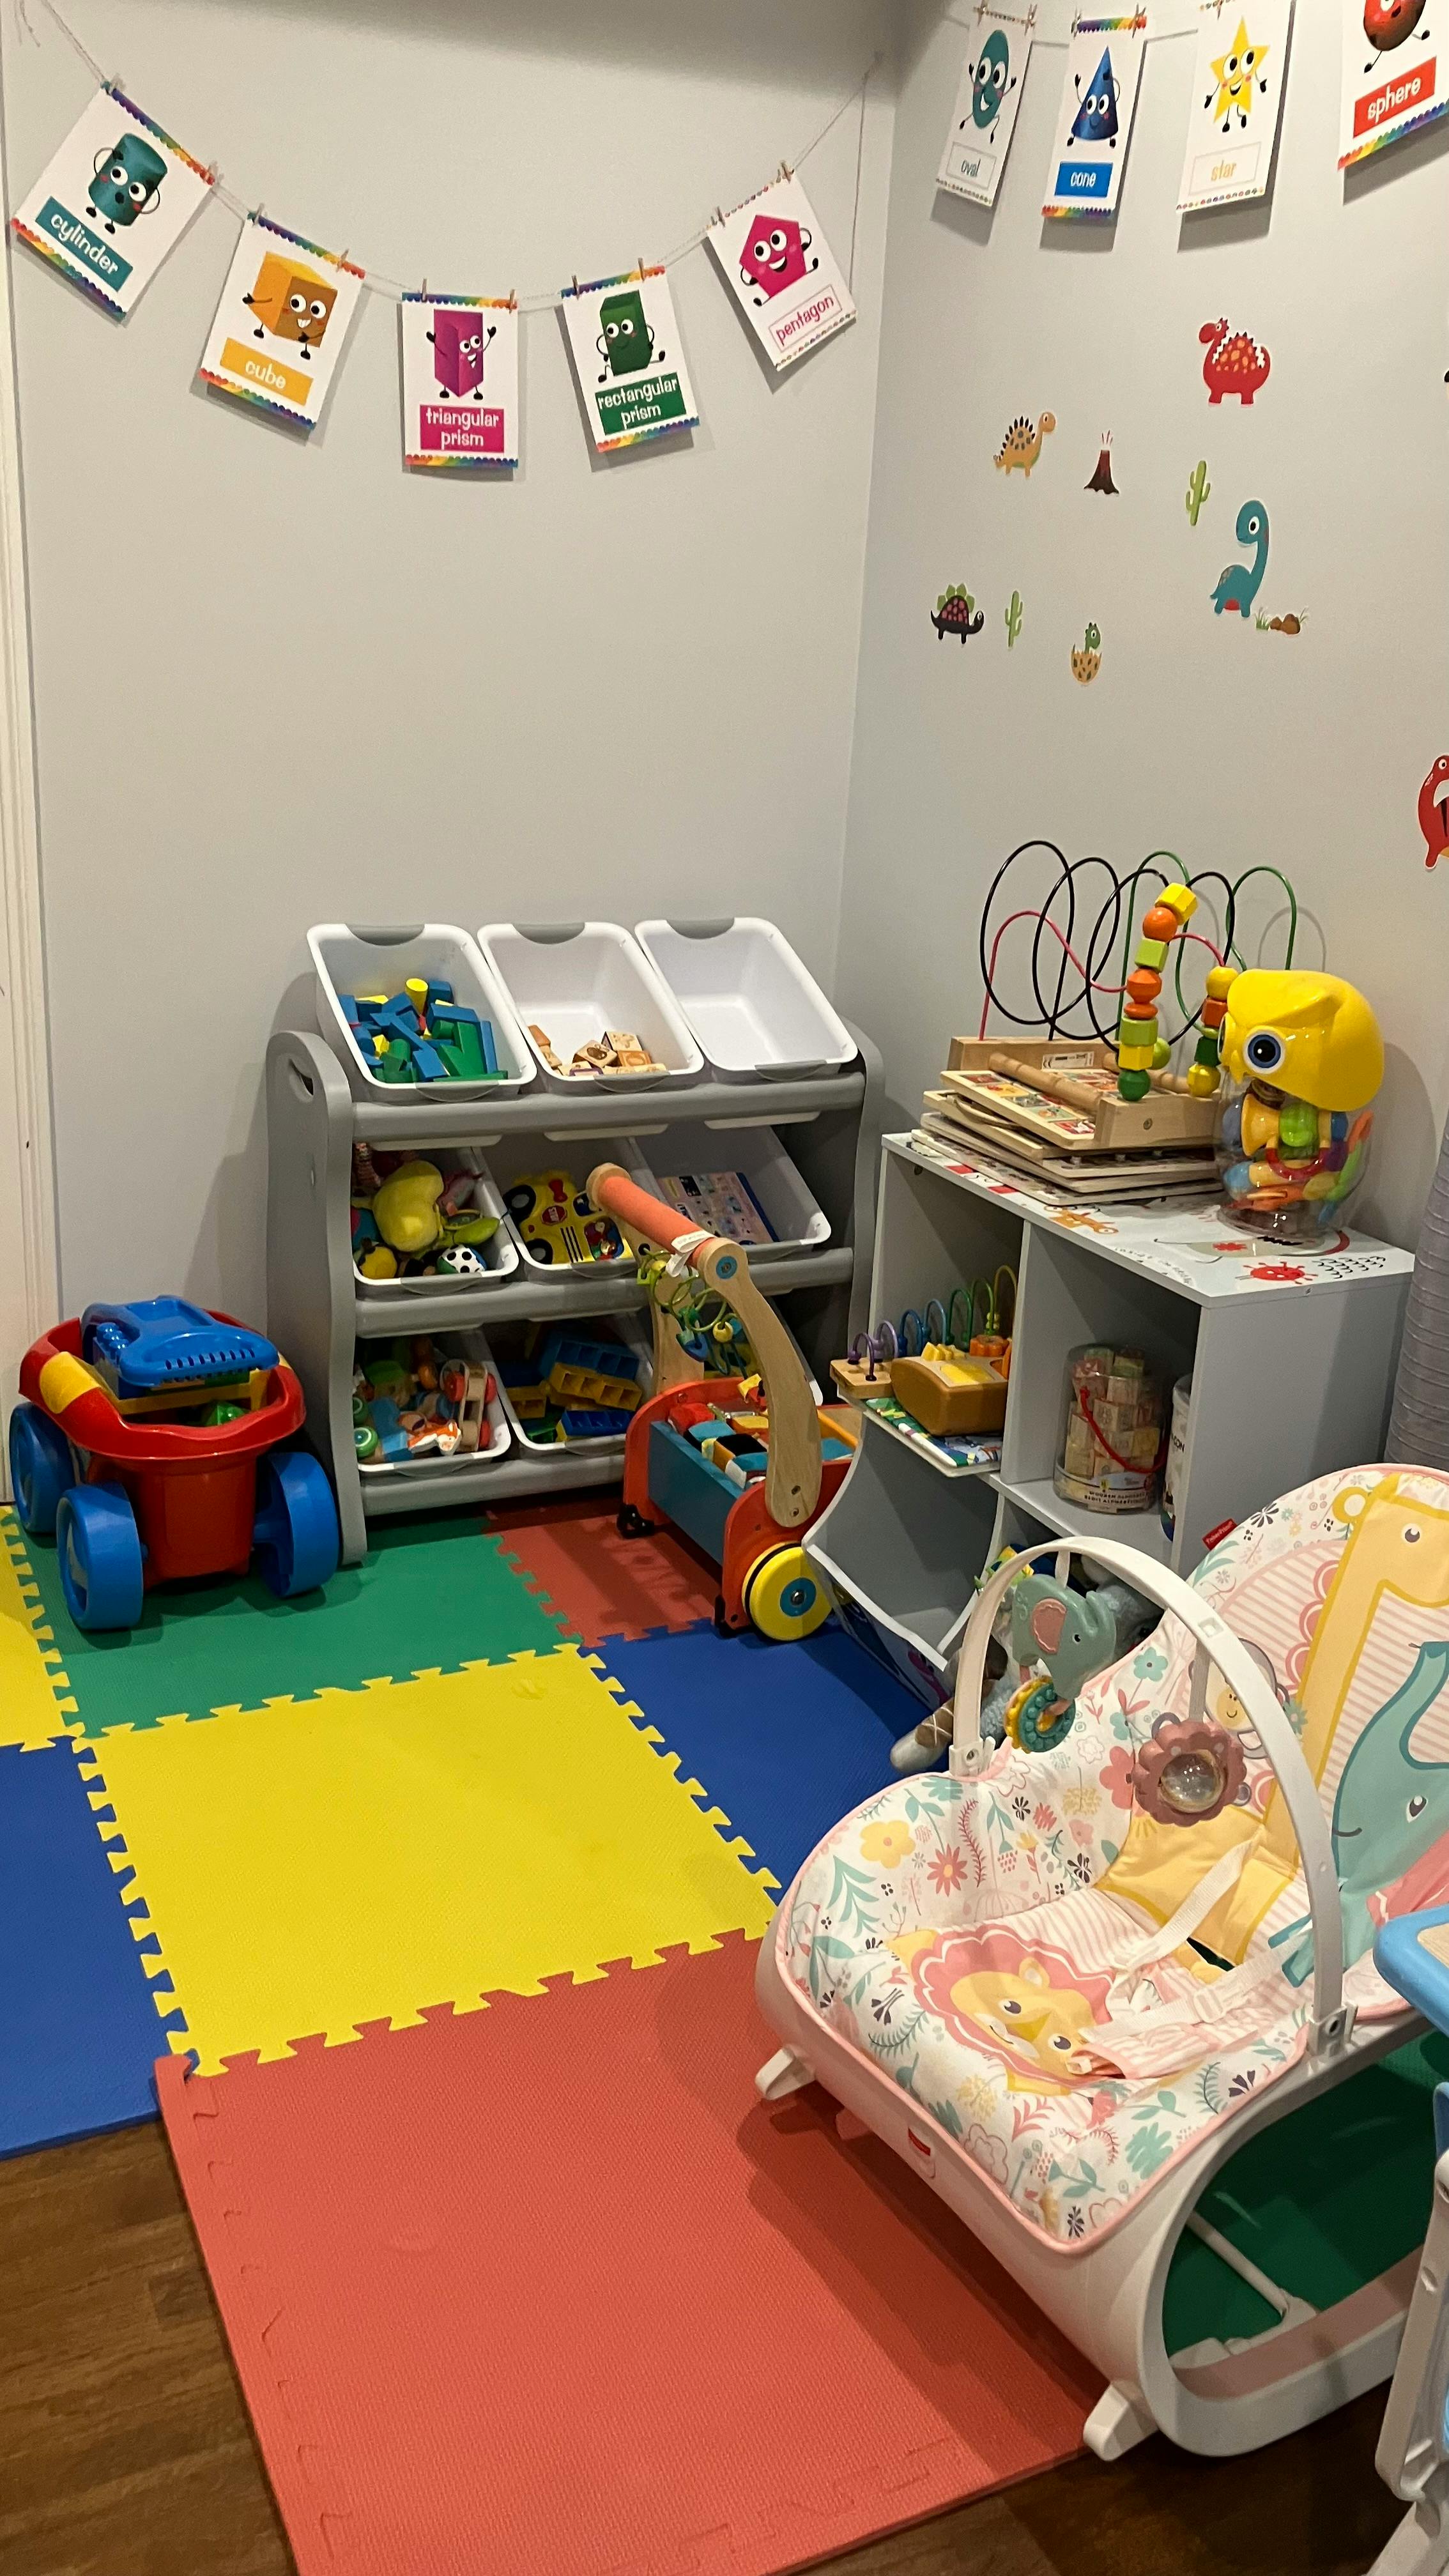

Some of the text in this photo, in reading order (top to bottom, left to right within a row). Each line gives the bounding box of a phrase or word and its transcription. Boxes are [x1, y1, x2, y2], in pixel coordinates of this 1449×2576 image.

[1367, 76, 1422, 123] sphere
[960, 158, 981, 177] oval
[1070, 171, 1097, 188] cone
[1211, 159, 1237, 182] star
[50, 213, 119, 275] cylinder
[775, 296, 834, 347] pentagon
[245, 360, 286, 389] cube
[597, 376, 678, 410] rectangular
[425, 406, 500, 431] triangular
[620, 404, 662, 430] prism
[441, 429, 484, 450] prism
